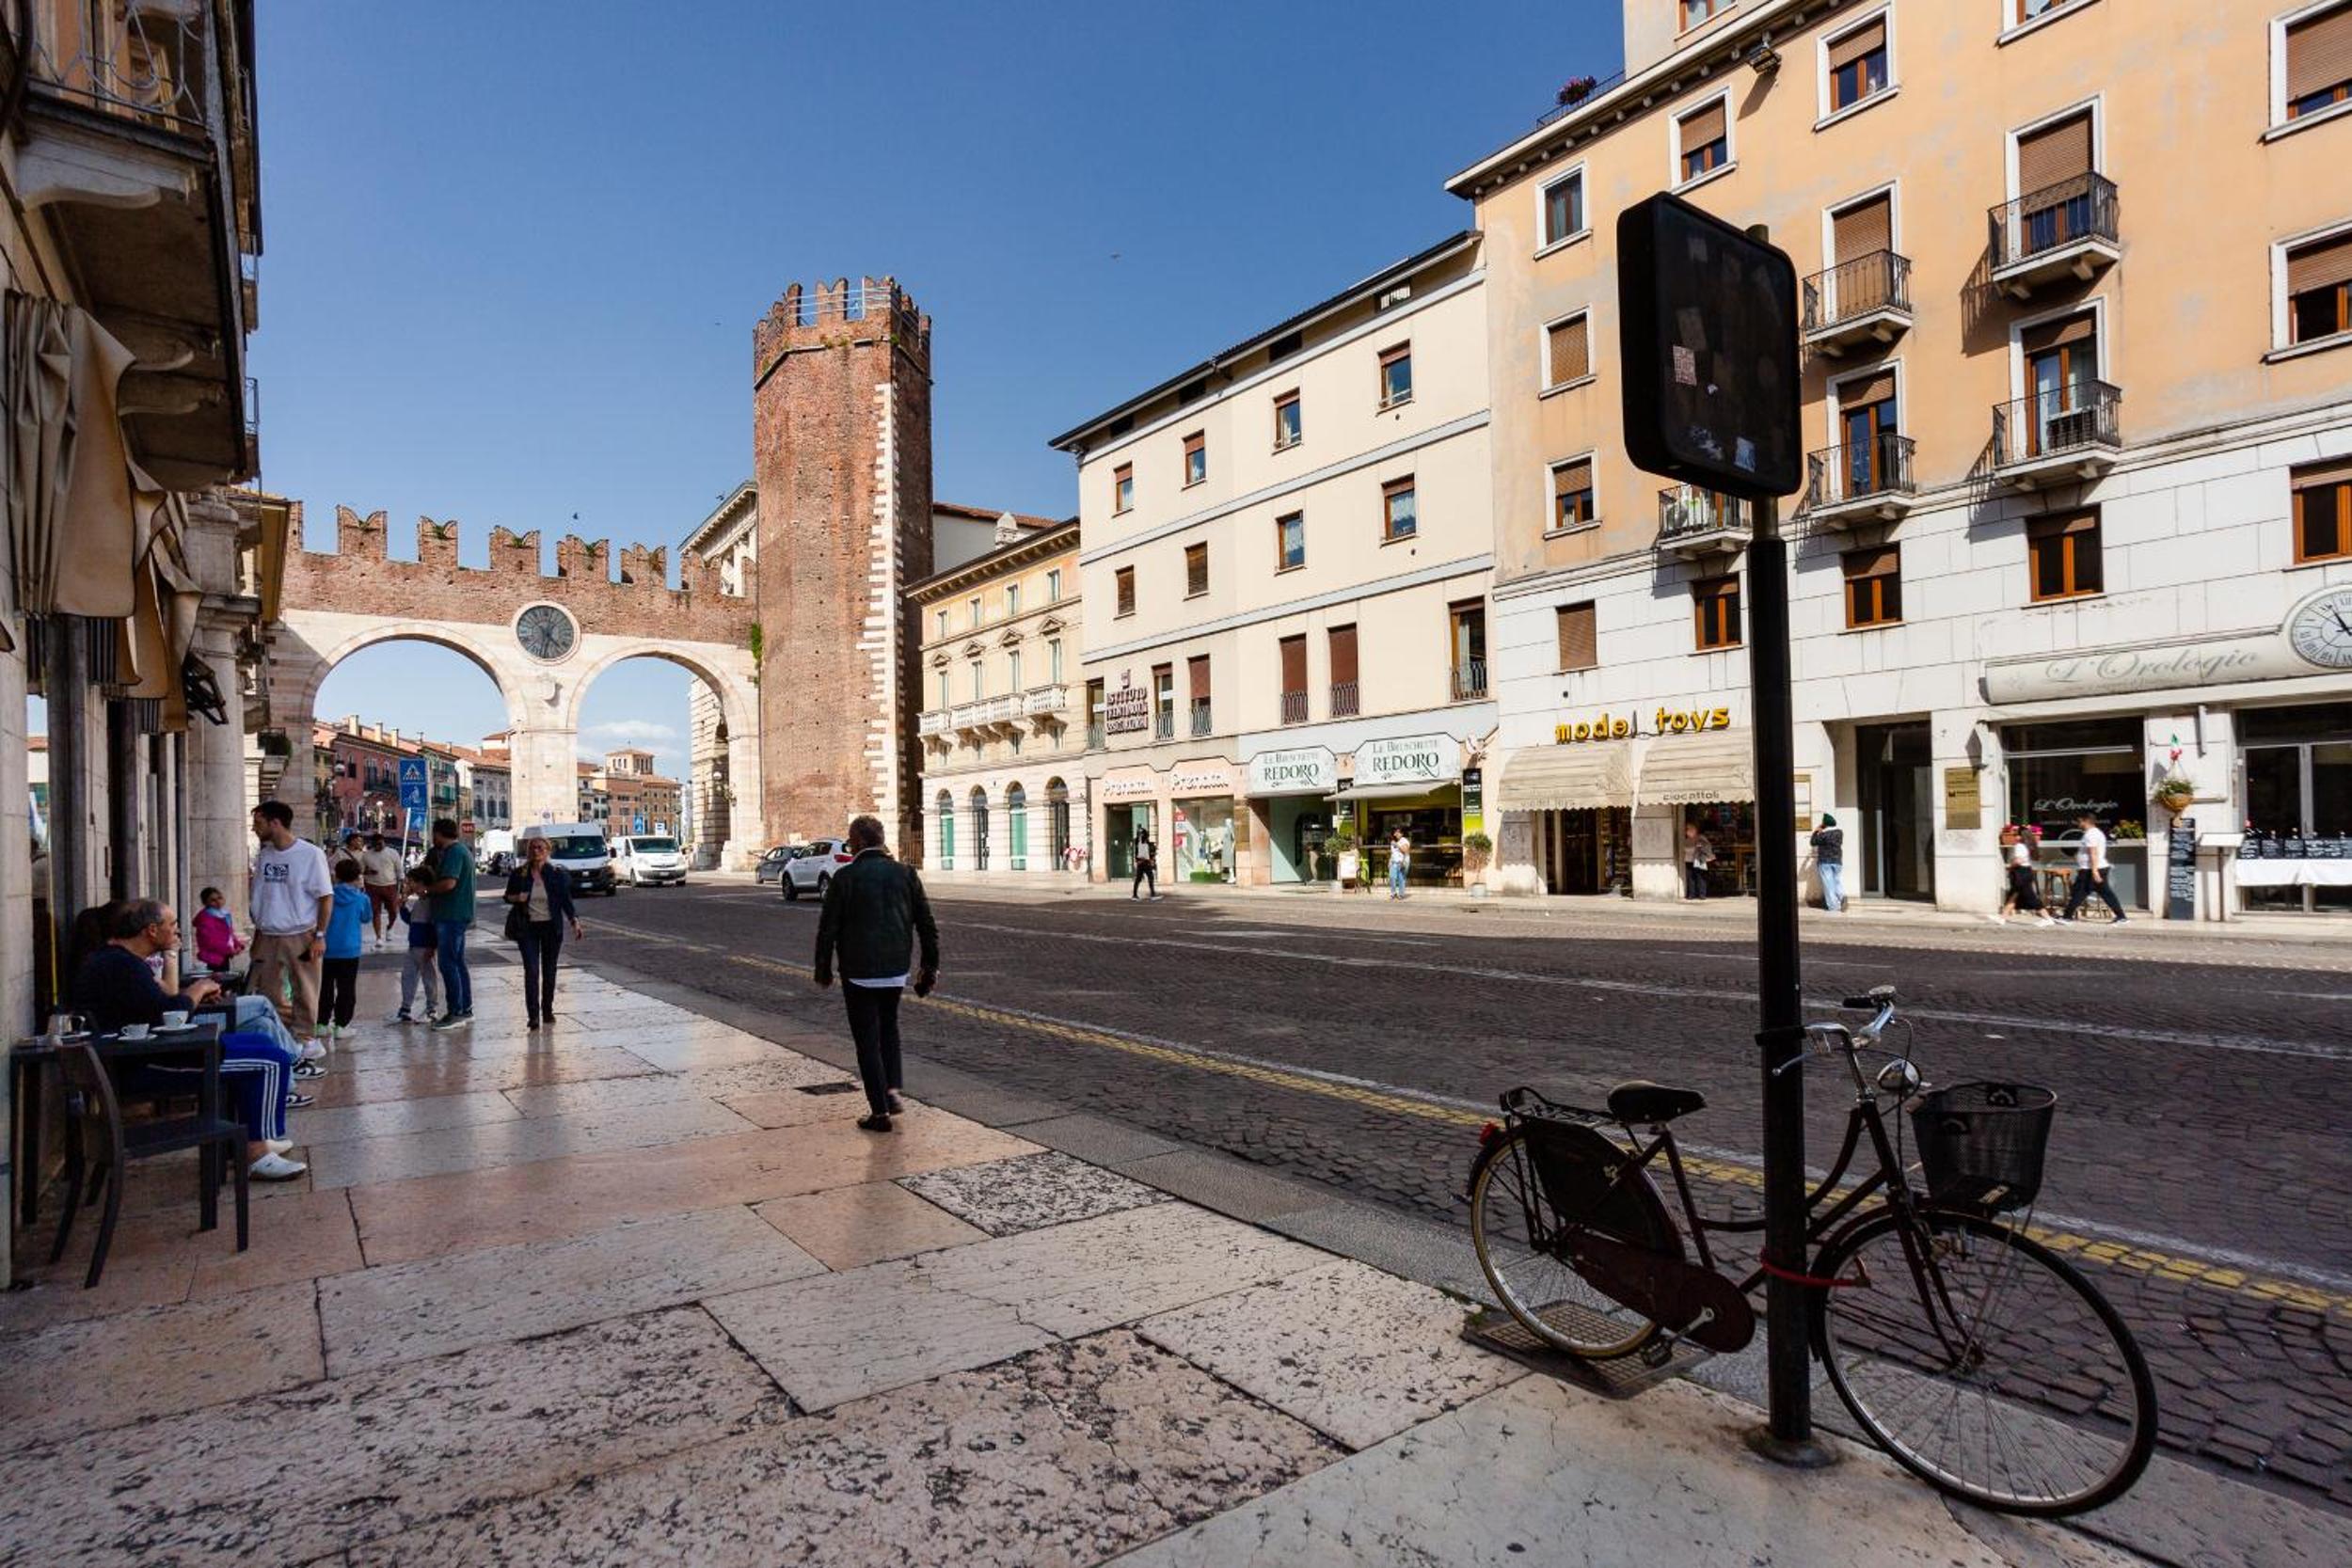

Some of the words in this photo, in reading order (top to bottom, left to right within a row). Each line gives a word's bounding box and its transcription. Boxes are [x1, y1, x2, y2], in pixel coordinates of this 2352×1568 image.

[2044, 648, 2259, 683] L'Orologio
[1555, 710, 1638, 744] model
[1656, 707, 1731, 736] toys
[1263, 764, 1320, 785] REDORO
[1373, 752, 1440, 778] REDORO
